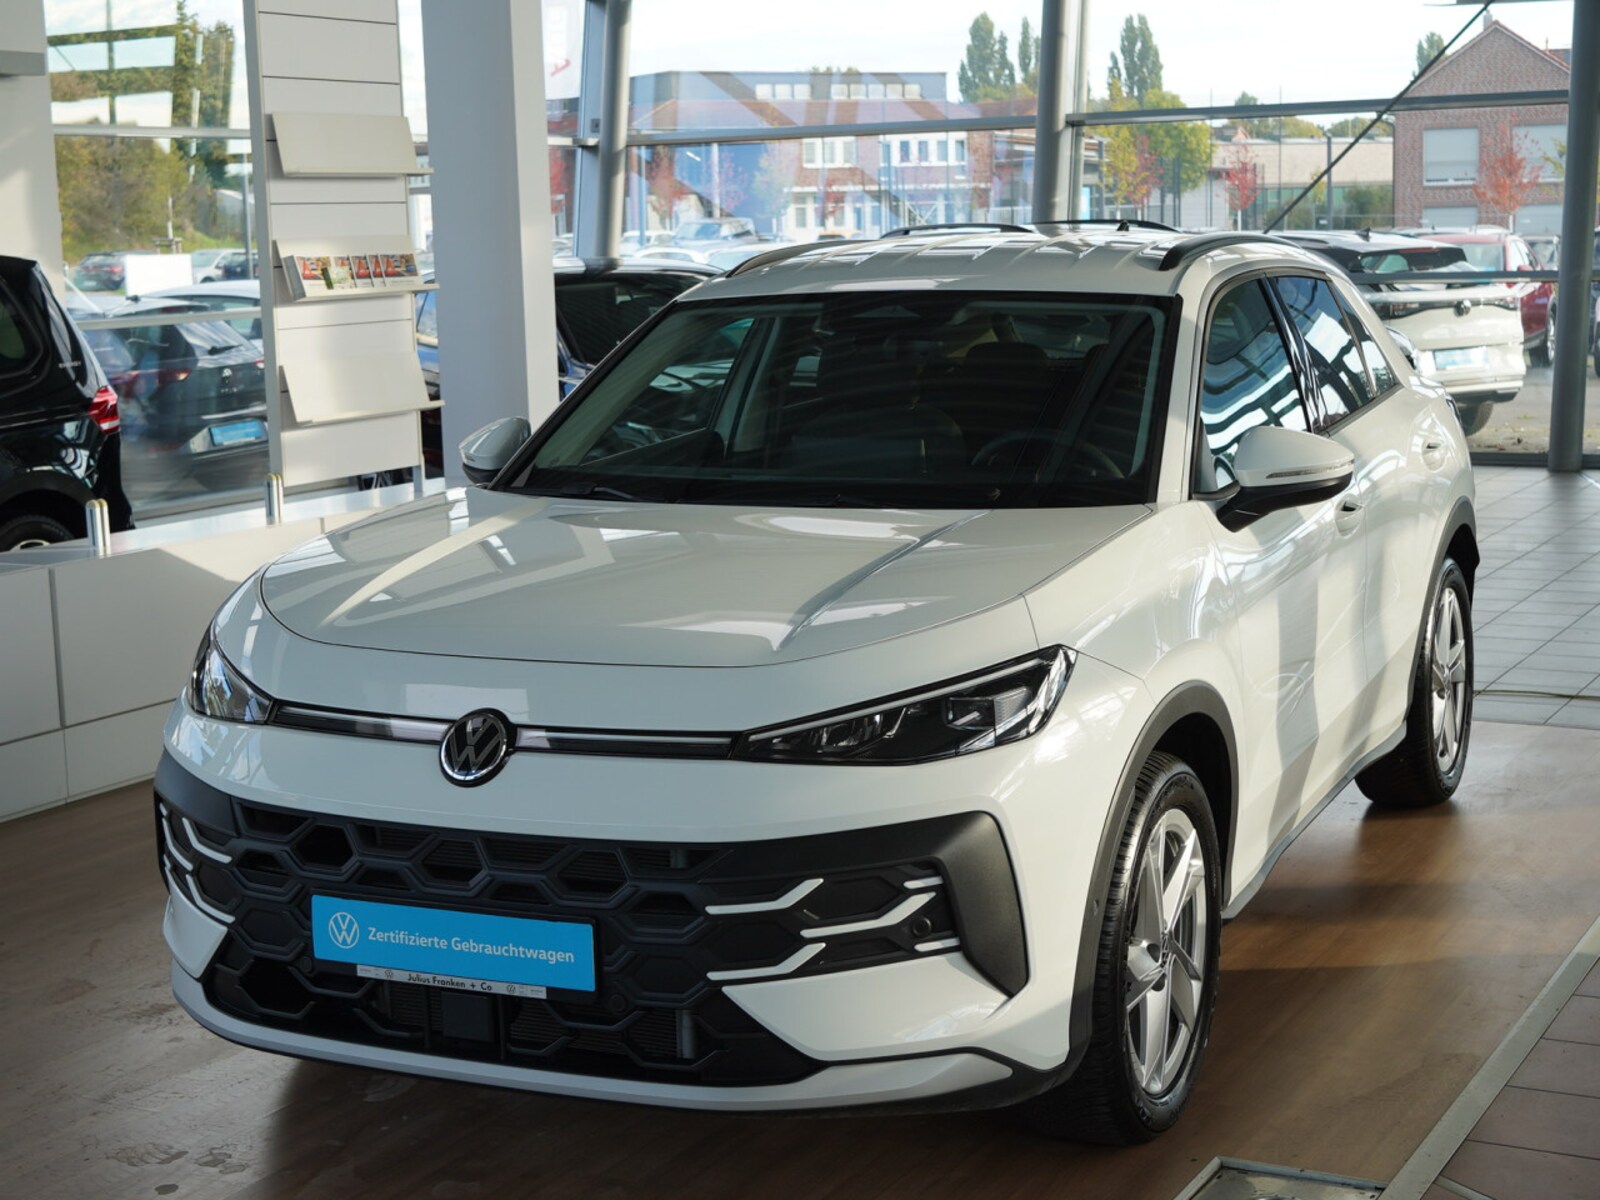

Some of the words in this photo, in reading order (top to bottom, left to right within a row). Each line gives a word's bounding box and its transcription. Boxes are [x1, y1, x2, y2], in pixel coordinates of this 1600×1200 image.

[328, 911, 360, 949] VW
[367, 926, 449, 950] Zertifizierte
[450, 936, 575, 965] Gebrauchtwagen
[407, 973, 431, 984] Julius
[432, 975, 465, 988] Franken
[480, 981, 493, 991] Co
